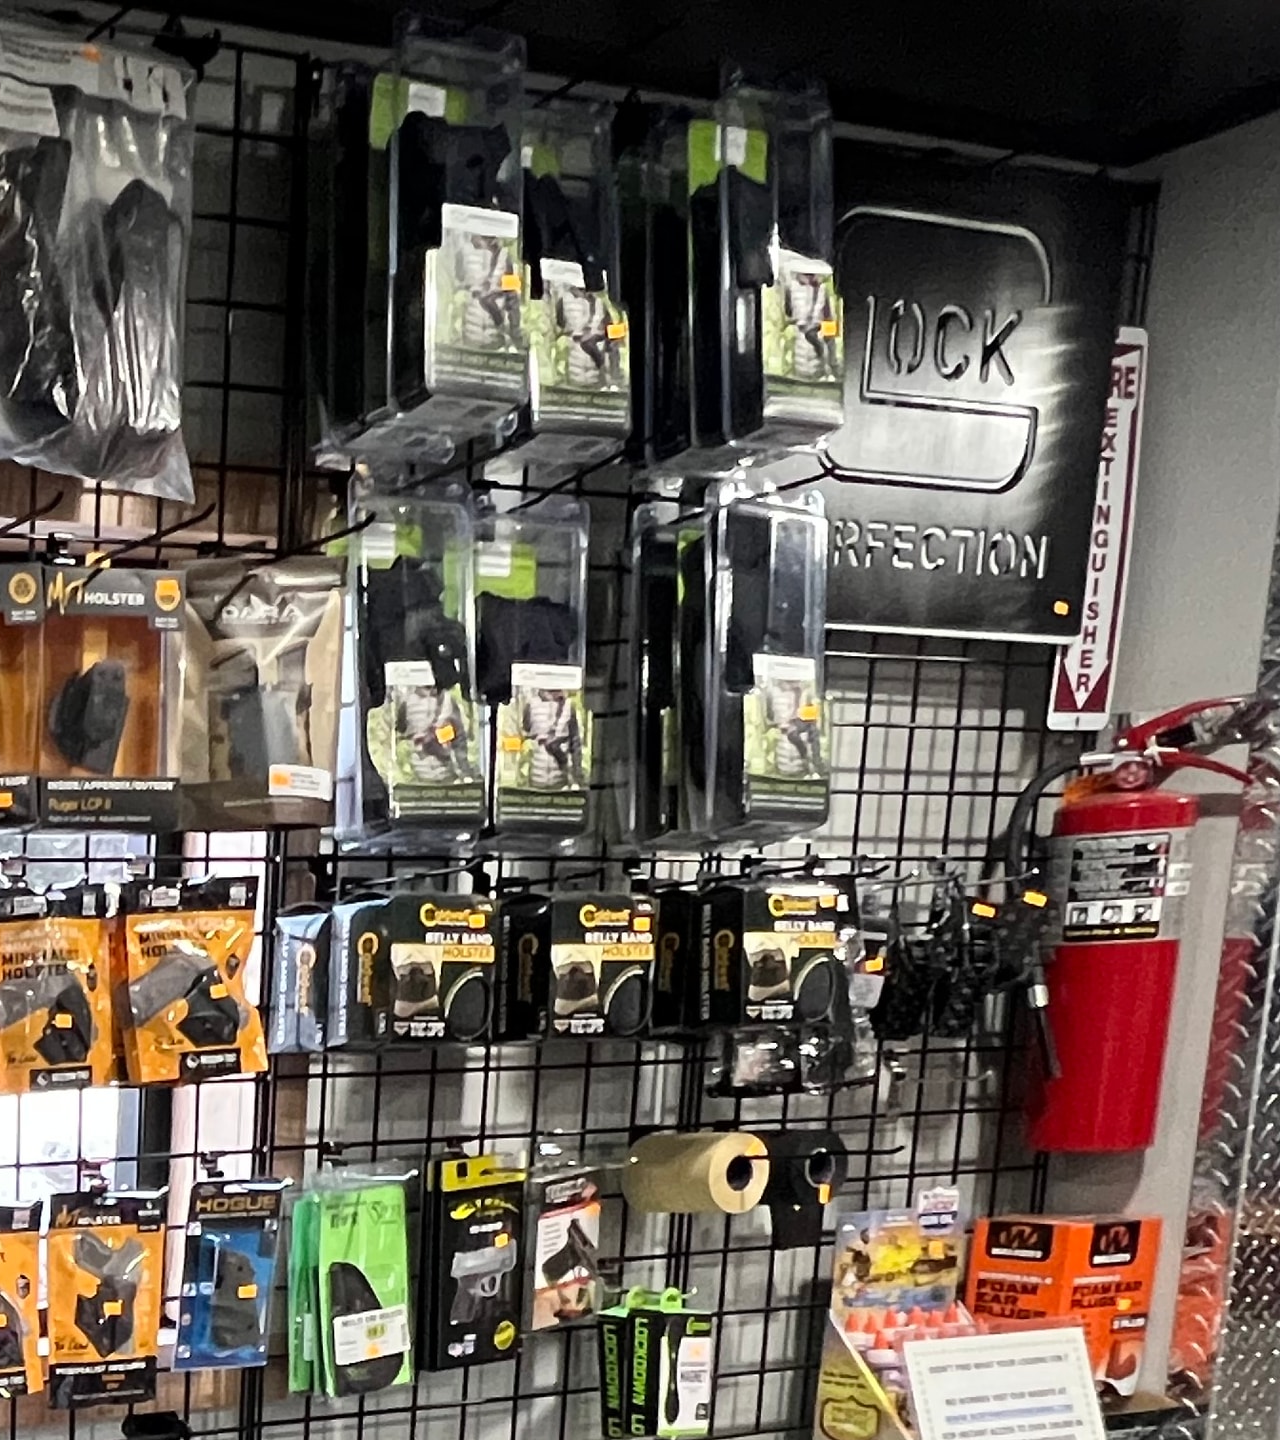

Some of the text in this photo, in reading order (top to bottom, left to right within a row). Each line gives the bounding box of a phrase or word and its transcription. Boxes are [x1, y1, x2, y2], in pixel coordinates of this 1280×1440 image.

[1111, 363, 1137, 402] RE
[833, 519, 1049, 580] RFECTION
[1075, 407, 1120, 695] EXTINGUISHER
[84, 591, 145, 606] HOLSTER
[195, 1194, 276, 1212] HOGUE
[976, 1278, 1039, 1296] FOAM
[631, 1317, 649, 1406] LOCKDOWN
